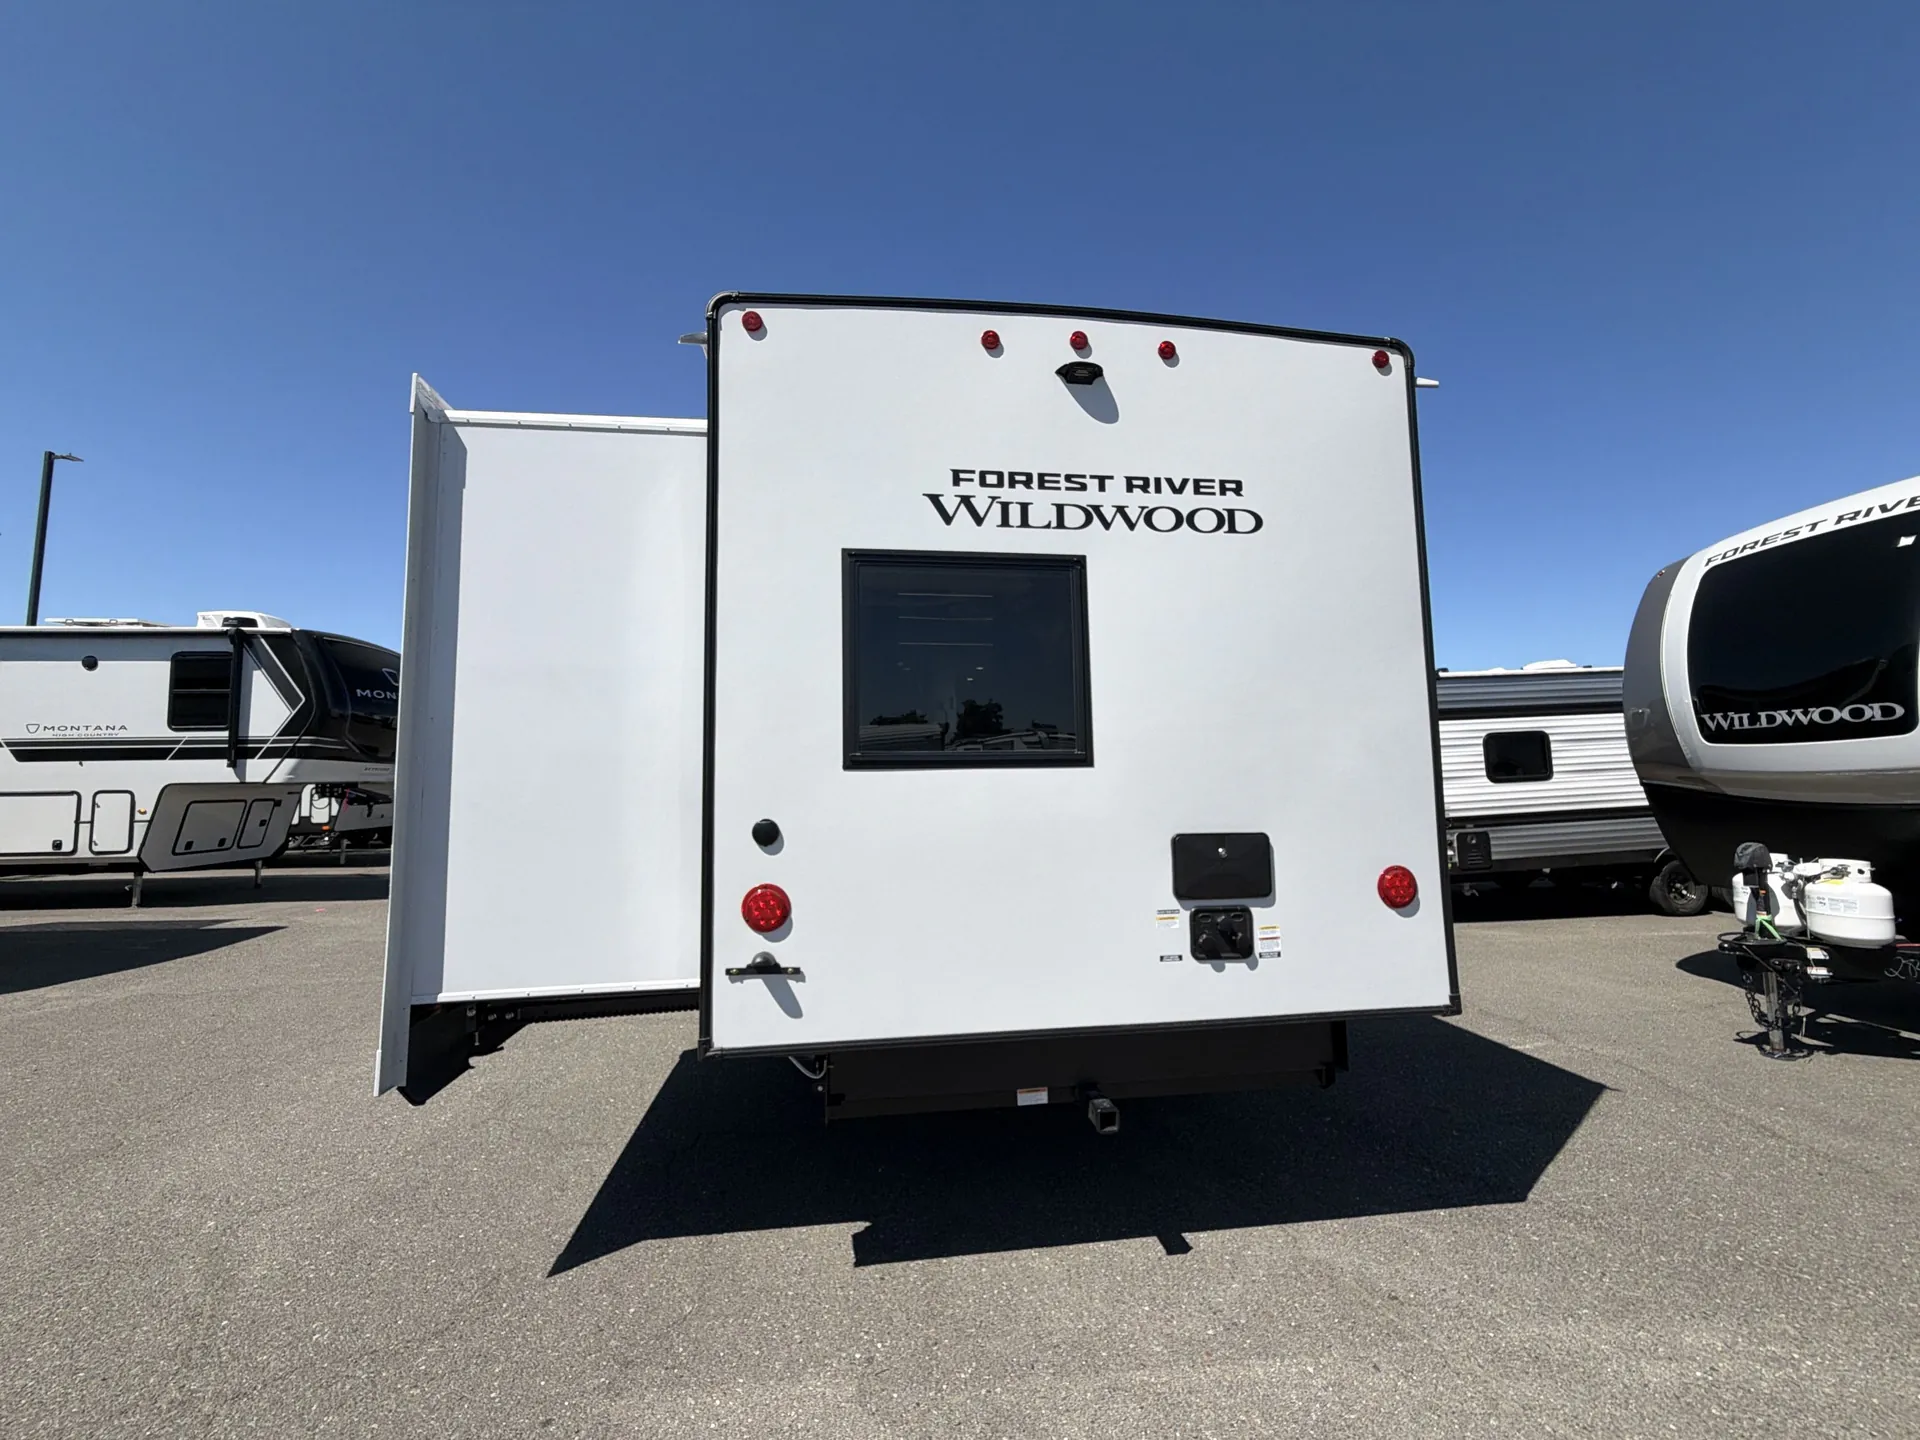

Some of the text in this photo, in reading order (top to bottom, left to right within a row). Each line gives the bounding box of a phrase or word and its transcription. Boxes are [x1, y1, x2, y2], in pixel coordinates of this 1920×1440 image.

[949, 468, 1245, 498] FOREST RIVER
[922, 493, 1264, 535] WILDWOOD
[1703, 518, 1829, 568] FOREST
[356, 688, 400, 701] MON
[1700, 702, 1906, 732] WILDWOOD
